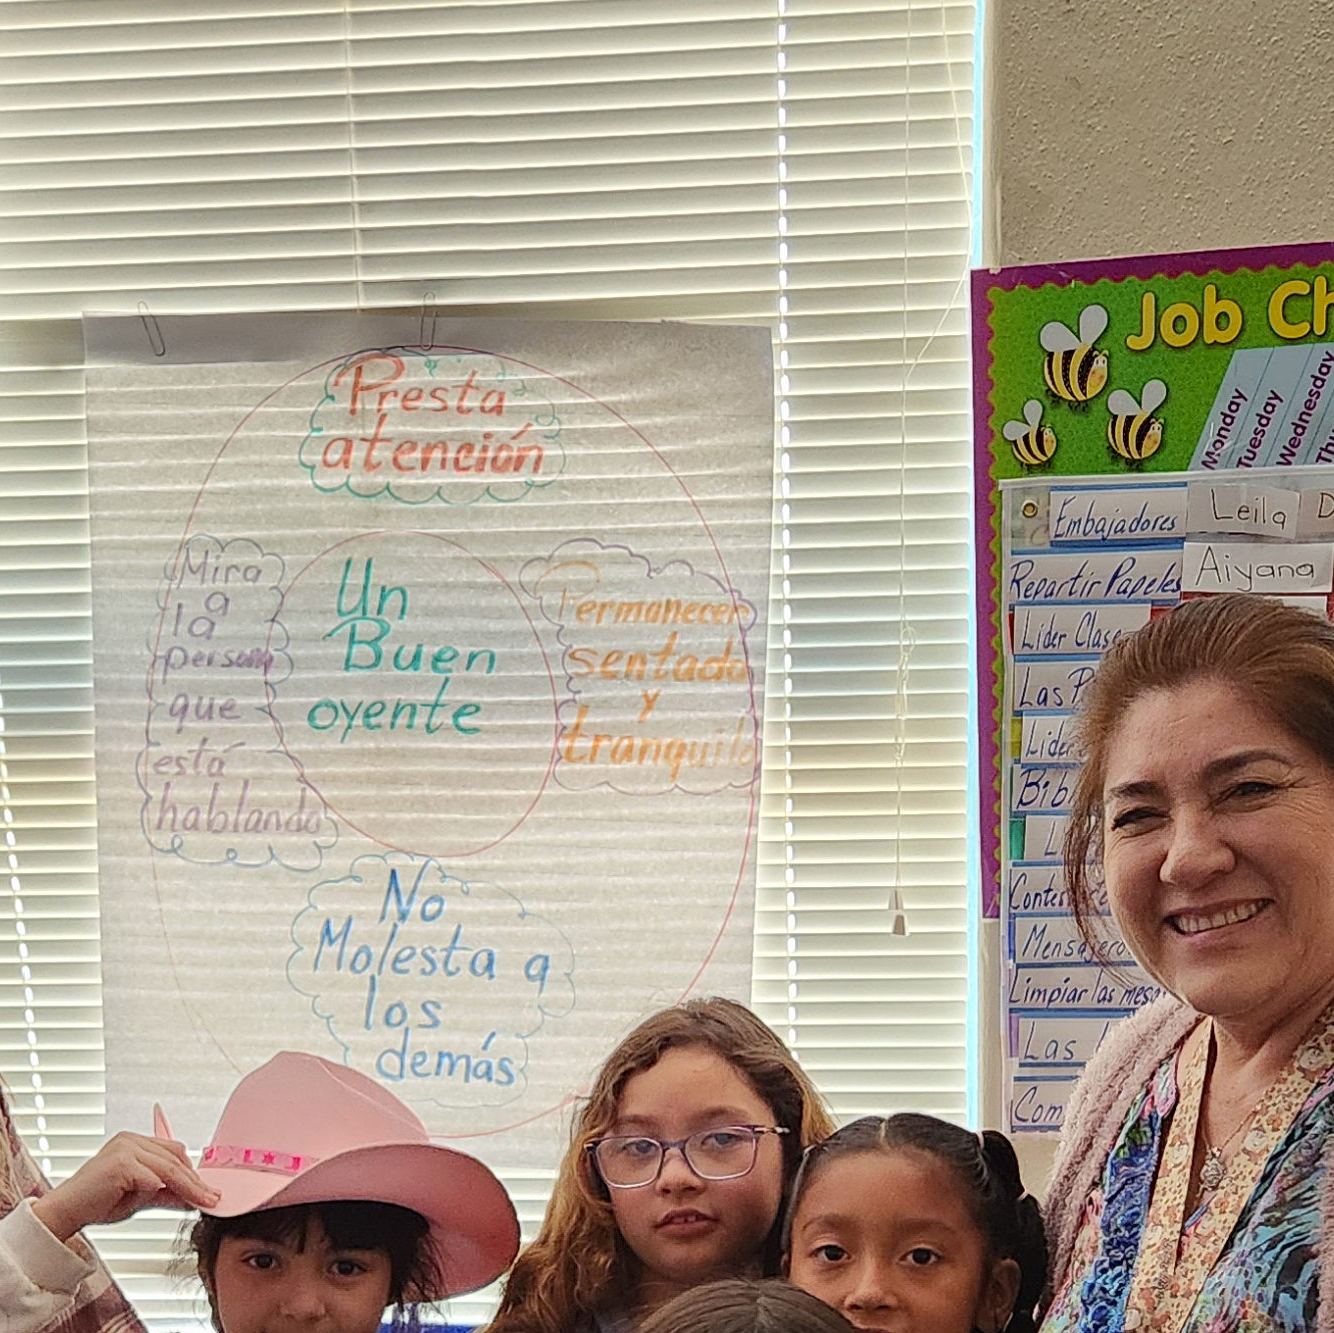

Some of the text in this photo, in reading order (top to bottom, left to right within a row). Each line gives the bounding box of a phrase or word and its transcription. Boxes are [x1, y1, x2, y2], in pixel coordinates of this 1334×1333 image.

[1126, 284, 1244, 351] Job
[333, 353, 506, 417] Presta
[321, 413, 544, 474] atención
[1201, 387, 1249, 471] Monday
[1236, 388, 1284, 469] Tuesday
[1053, 496, 1178, 540] Embajadores
[1210, 488, 1287, 530] Leila
[176, 547, 263, 590] Mira
[337, 556, 409, 621] Un
[533, 559, 750, 626] Permanecer
[1009, 546, 1315, 600] Repartir Papeles Aiyana
[172, 602, 217, 640] la
[204, 591, 230, 617] a
[322, 616, 496, 675] Buen
[568, 631, 748, 682] sentado
[169, 693, 241, 735] que
[307, 675, 483, 744] oyente
[1019, 666, 1064, 708] Las
[153, 736, 246, 778] está
[561, 703, 756, 783] tranquilo
[156, 779, 322, 834] hablando
[379, 857, 446, 925] No
[313, 914, 496, 981] Molesta
[364, 973, 443, 1031] los
[1008, 968, 1089, 1009] Limpiar
[375, 1026, 516, 1086] demás
[1023, 1021, 1077, 1061] Las
